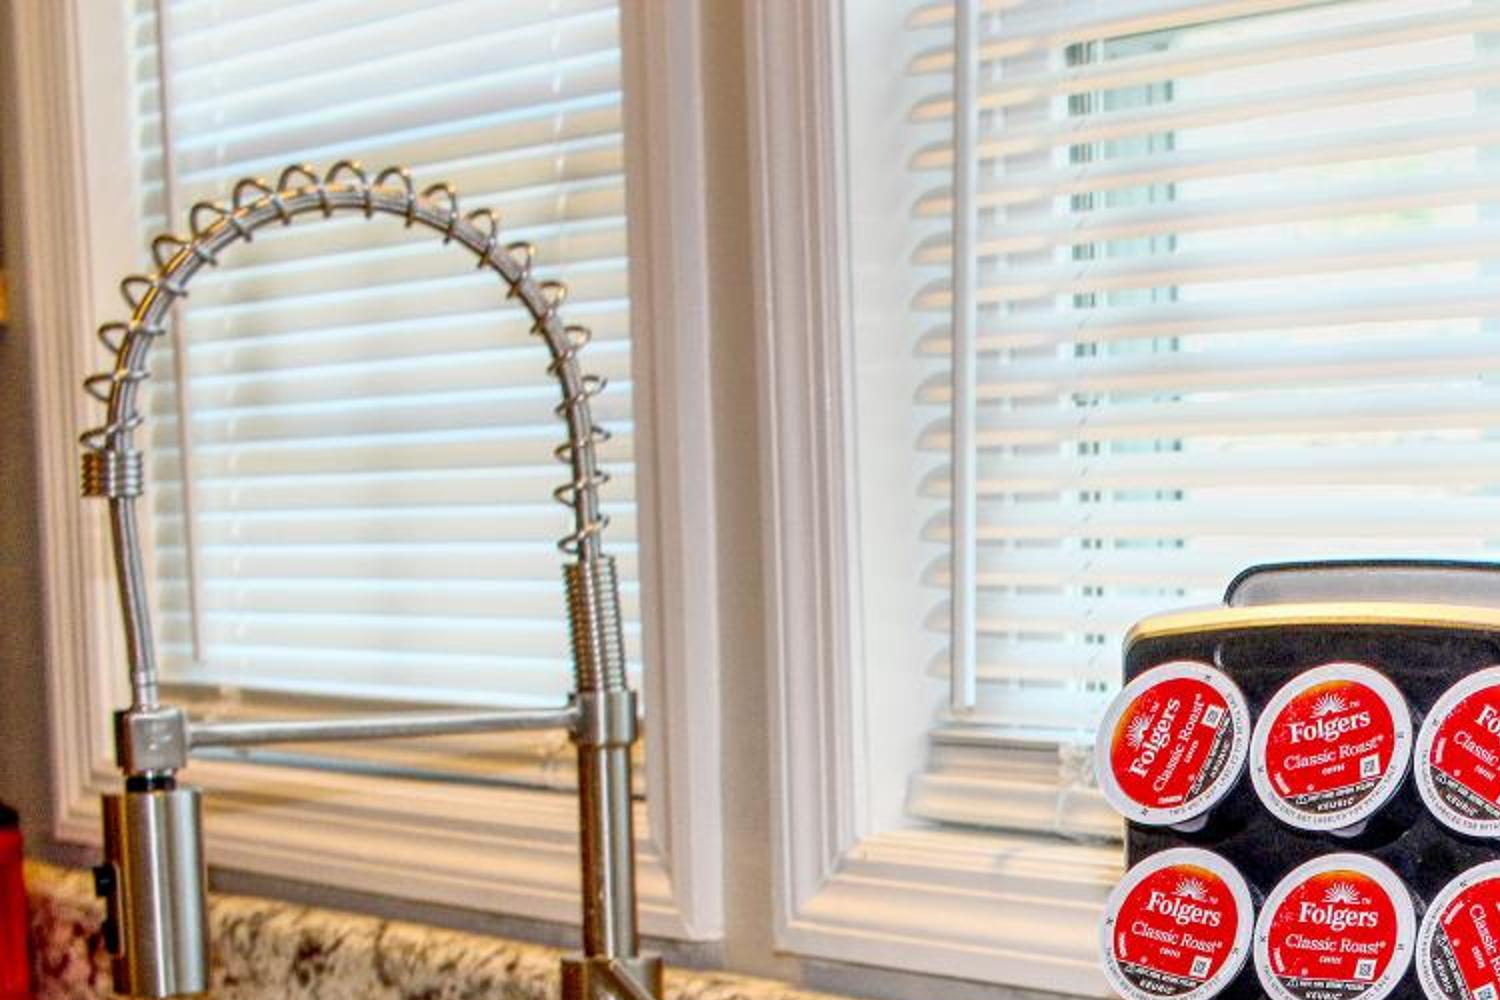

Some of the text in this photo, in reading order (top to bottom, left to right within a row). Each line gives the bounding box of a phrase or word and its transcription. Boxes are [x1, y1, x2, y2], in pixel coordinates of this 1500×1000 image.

[1129, 698, 1180, 778] Folgers
[1288, 710, 1370, 744] Folgers
[1284, 749, 1336, 771] Classic
[1453, 730, 1499, 766] Classic
[1153, 745, 1184, 792] Classic
[1145, 891, 1221, 927] Folgers
[1298, 901, 1379, 931] Folgers
[1131, 920, 1178, 944] Classic
[1285, 933, 1337, 952] Classic
[1469, 903, 1497, 956] Classic
